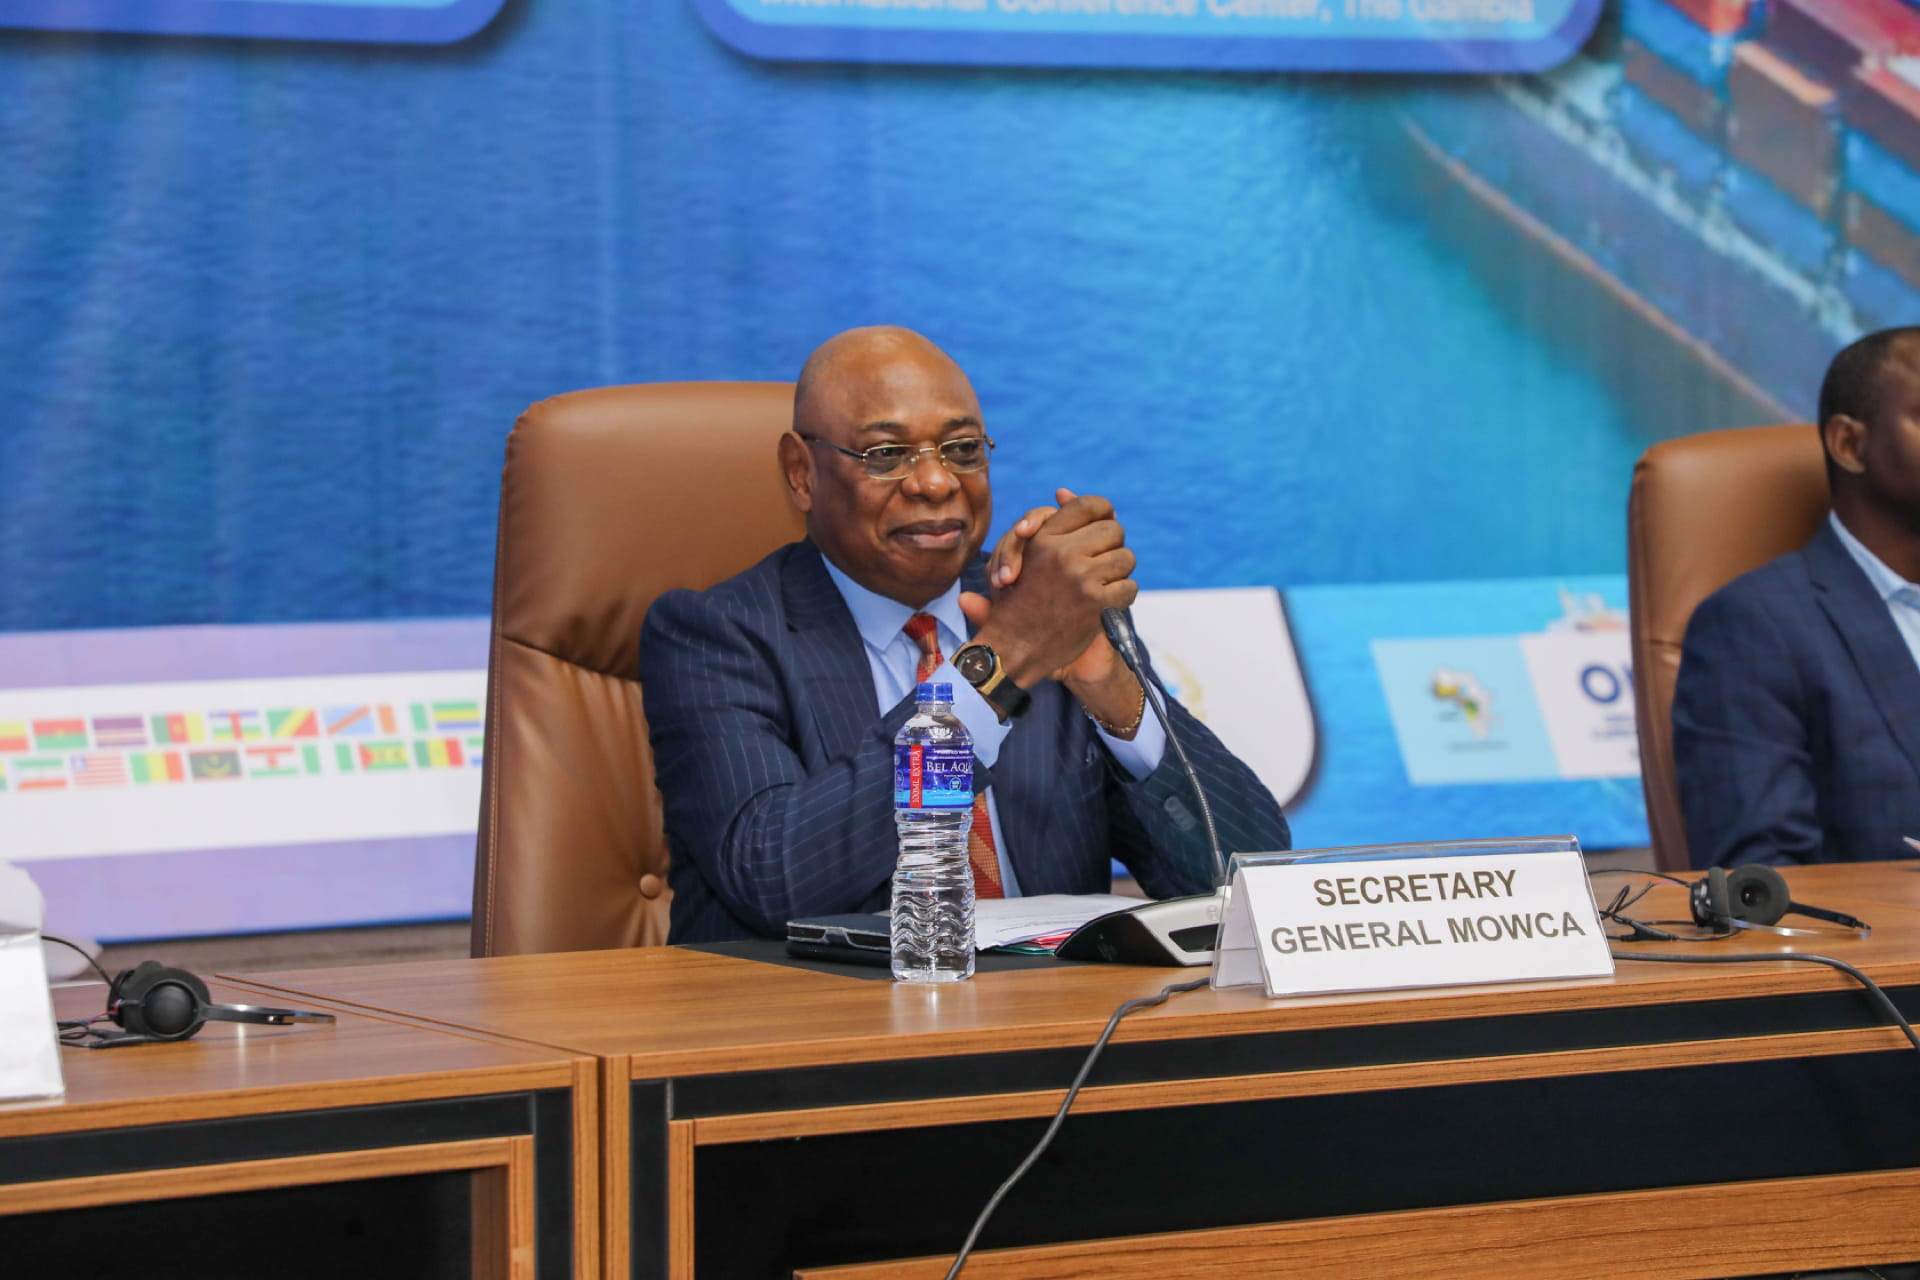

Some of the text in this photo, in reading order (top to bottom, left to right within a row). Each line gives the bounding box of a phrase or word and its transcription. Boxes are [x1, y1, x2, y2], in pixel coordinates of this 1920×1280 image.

[926, 761, 948, 772] BEL
[1313, 869, 1516, 906] SECRETARY
[1271, 911, 1585, 954] GENERAL MOWCA
